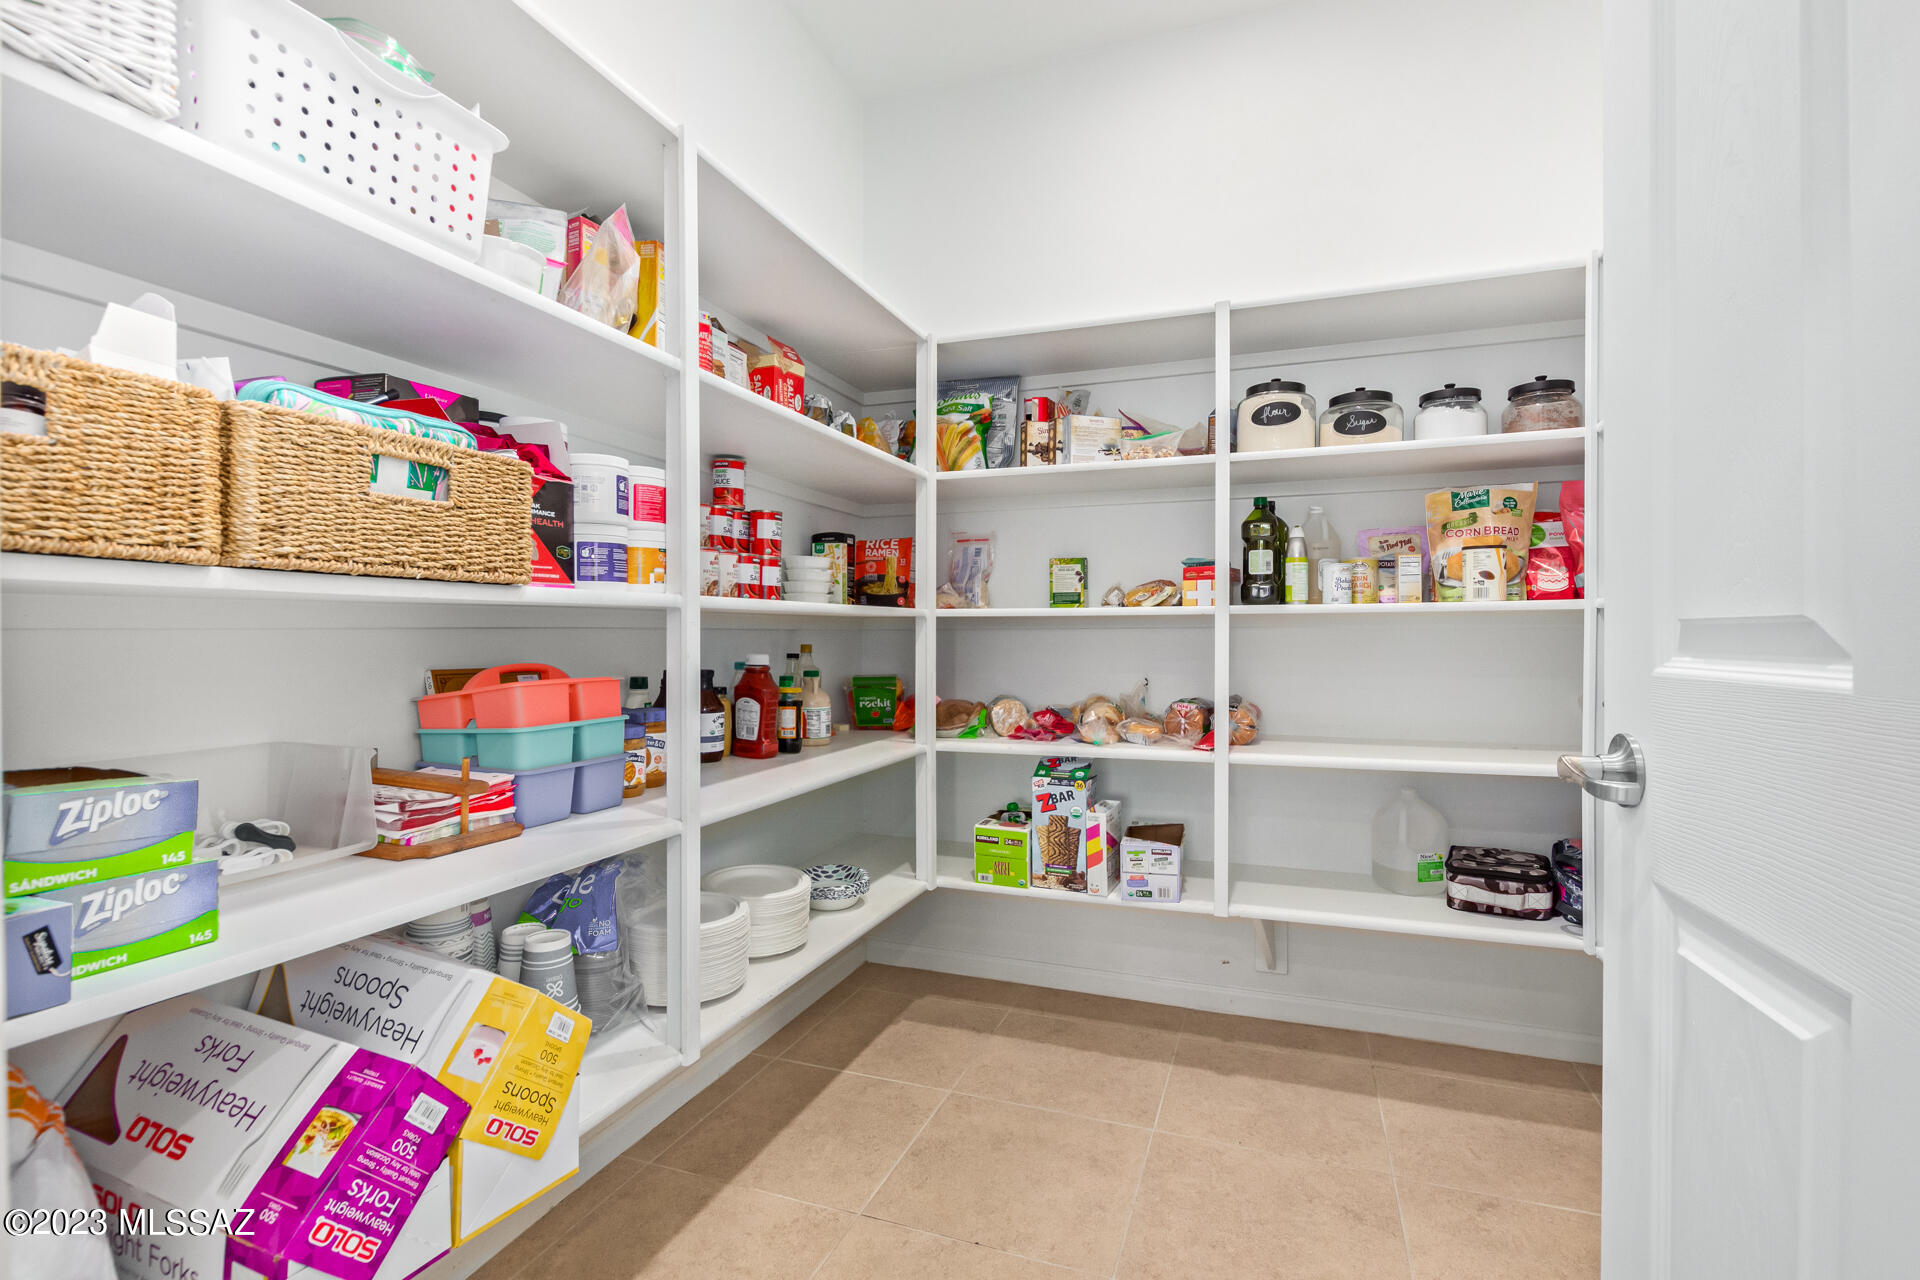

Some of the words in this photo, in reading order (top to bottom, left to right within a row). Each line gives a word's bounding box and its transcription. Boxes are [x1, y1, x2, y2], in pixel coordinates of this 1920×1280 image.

[1262, 406, 1292, 424] flour
[1345, 415, 1378, 431] Sugar
[865, 539, 899, 549] RICE
[1445, 527, 1481, 539] CORN
[1483, 525, 1520, 537] BREAD
[864, 548, 899, 557] RAMEN
[859, 698, 891, 708] rockit
[56, 789, 161, 838] Ziploc
[161, 851, 186, 865] 145
[80, 872, 181, 929] Ziploc
[189, 930, 212, 945] 145
[588, 929, 612, 937] FOAM
[71, 953, 128, 976] DWICH
[334, 966, 409, 1009] Spoons
[300, 990, 424, 1054] Heavyweight
[194, 1035, 254, 1073] Forks
[540, 1049, 559, 1065] 500
[128, 1059, 267, 1132] Heavyweight
[502, 1081, 557, 1114] Spoons
[494, 1099, 550, 1126] Heavyweight
[125, 1115, 194, 1161] SOLO
[486, 1118, 539, 1146] SOLO
[391, 1138, 417, 1160] 500
[346, 1179, 400, 1218] Forks
[259, 1208, 279, 1225] 500
[324, 1198, 395, 1237] Heavyweight
[309, 1220, 381, 1262] SOLO
